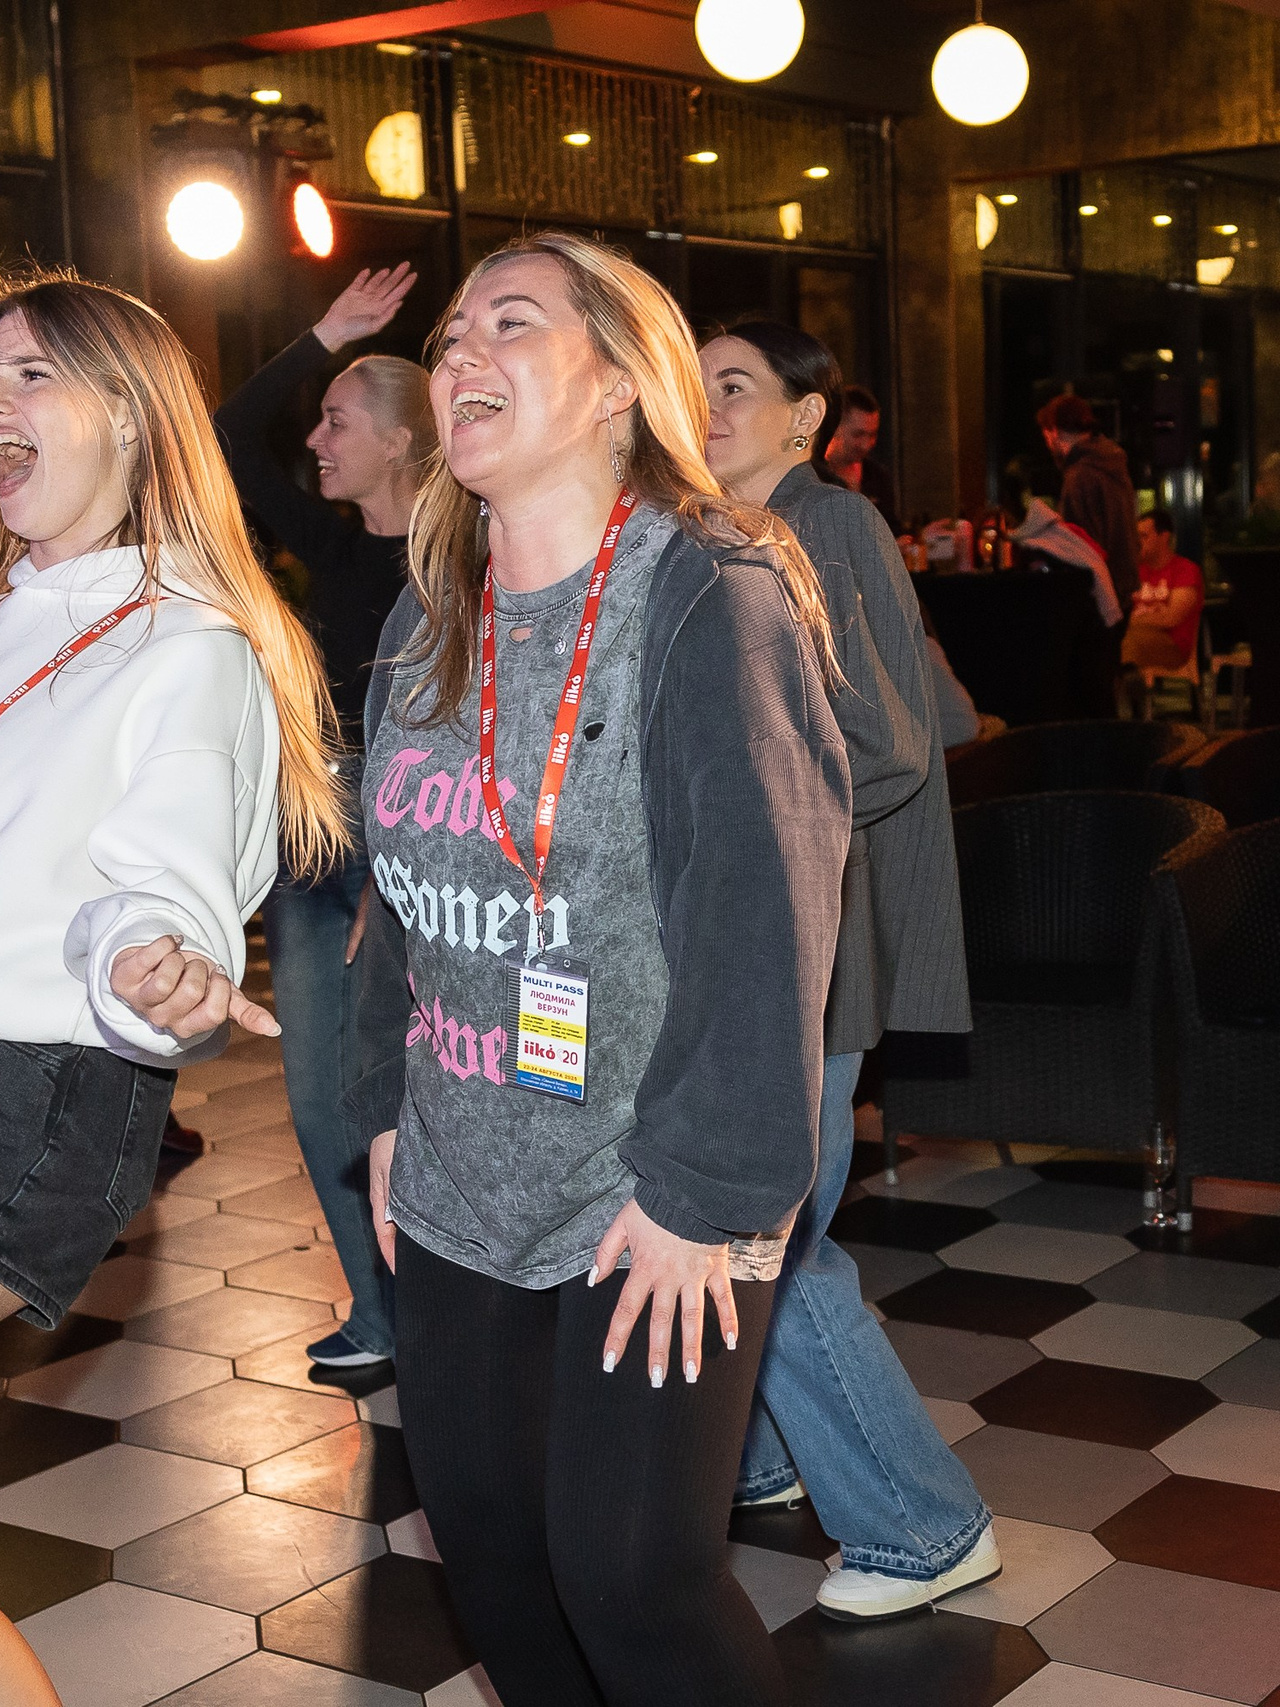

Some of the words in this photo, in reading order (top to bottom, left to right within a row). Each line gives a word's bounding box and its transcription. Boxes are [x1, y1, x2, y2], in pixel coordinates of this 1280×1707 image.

[523, 976, 553, 988] MULTI
[556, 983, 584, 995] PASS
[530, 990, 576, 1007] ЛЮДМИЛА
[537, 1002, 568, 1016] ВЕРЗУН
[562, 1050, 578, 1065] 20
